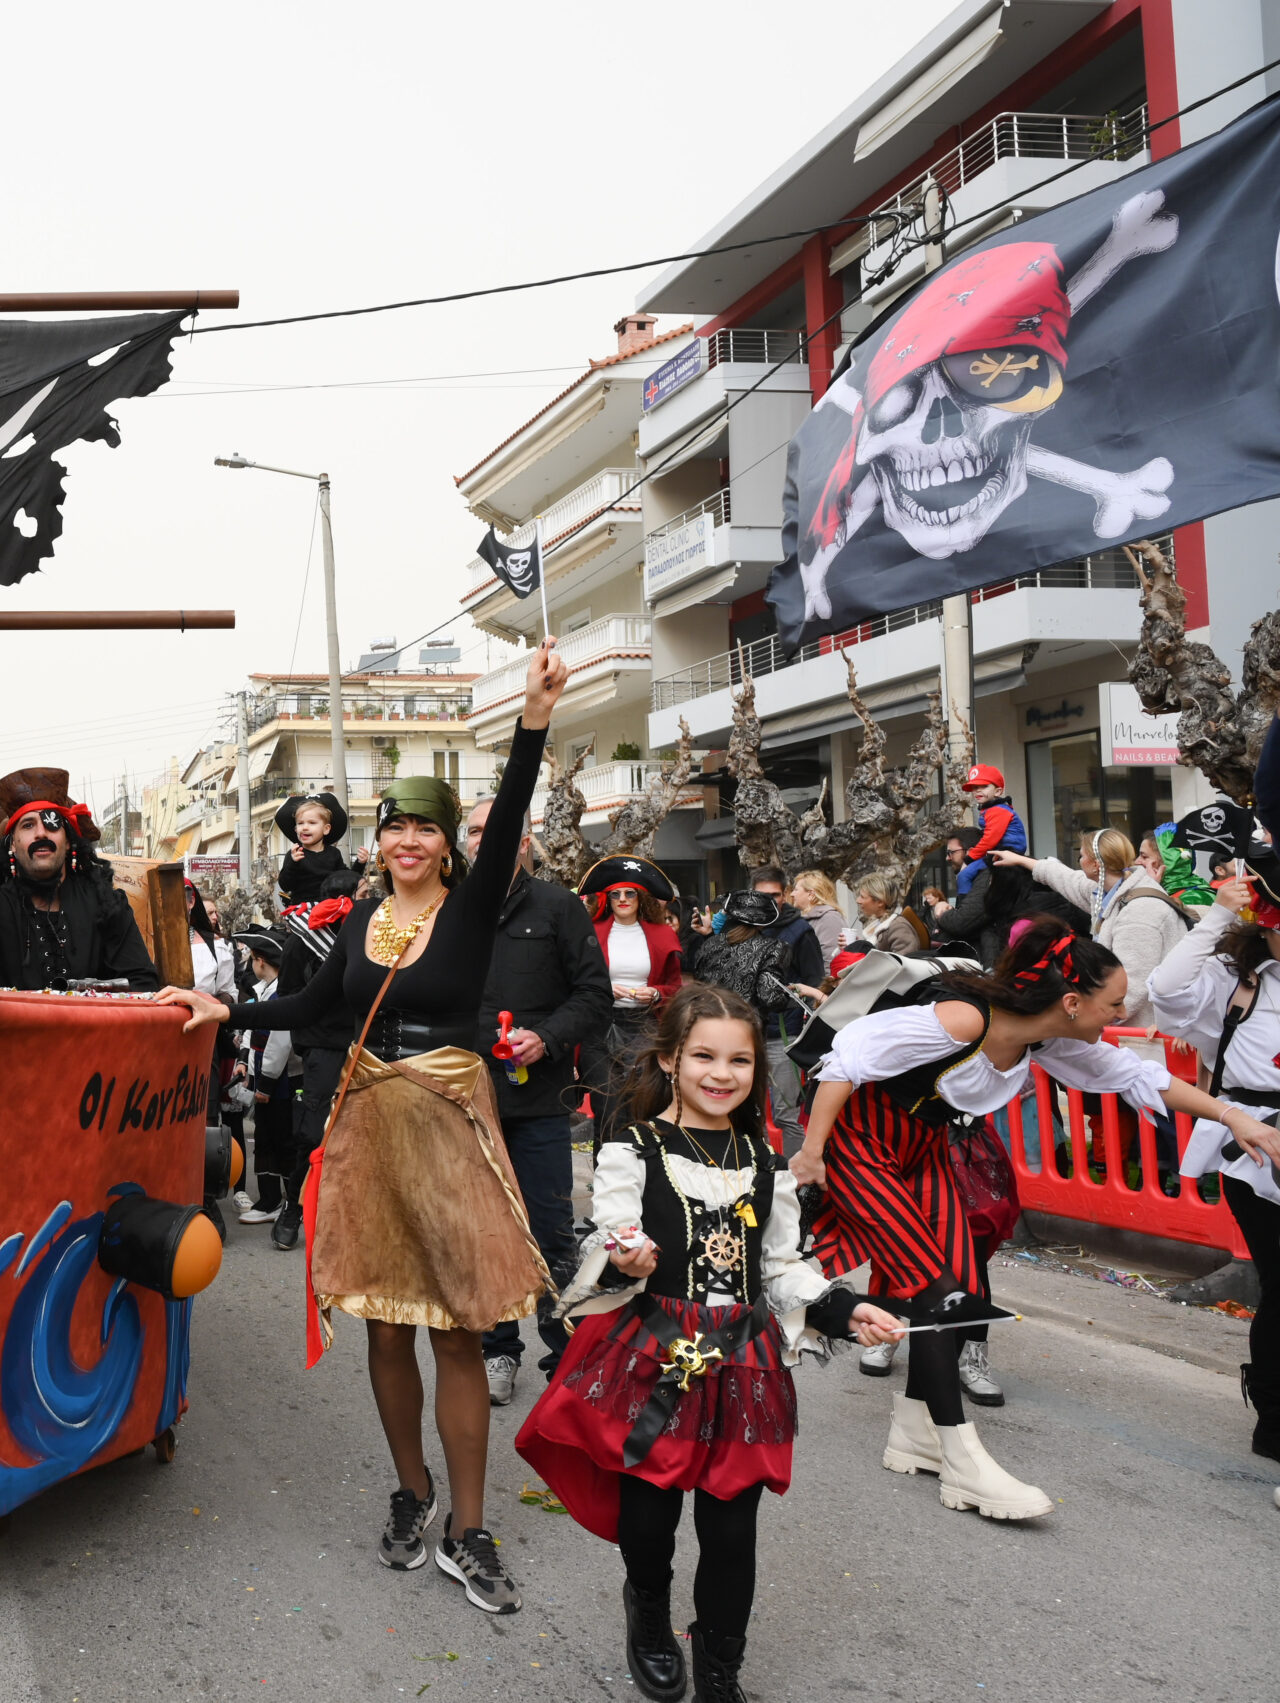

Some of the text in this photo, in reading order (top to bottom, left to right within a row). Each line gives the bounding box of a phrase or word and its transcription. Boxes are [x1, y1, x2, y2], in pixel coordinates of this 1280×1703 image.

[647, 528, 690, 564] DENTAL CLINIC
[1114, 722, 1179, 745] Marvelo
[1115, 752, 1144, 762] NAILS
[1146, 752, 1153, 762] &
